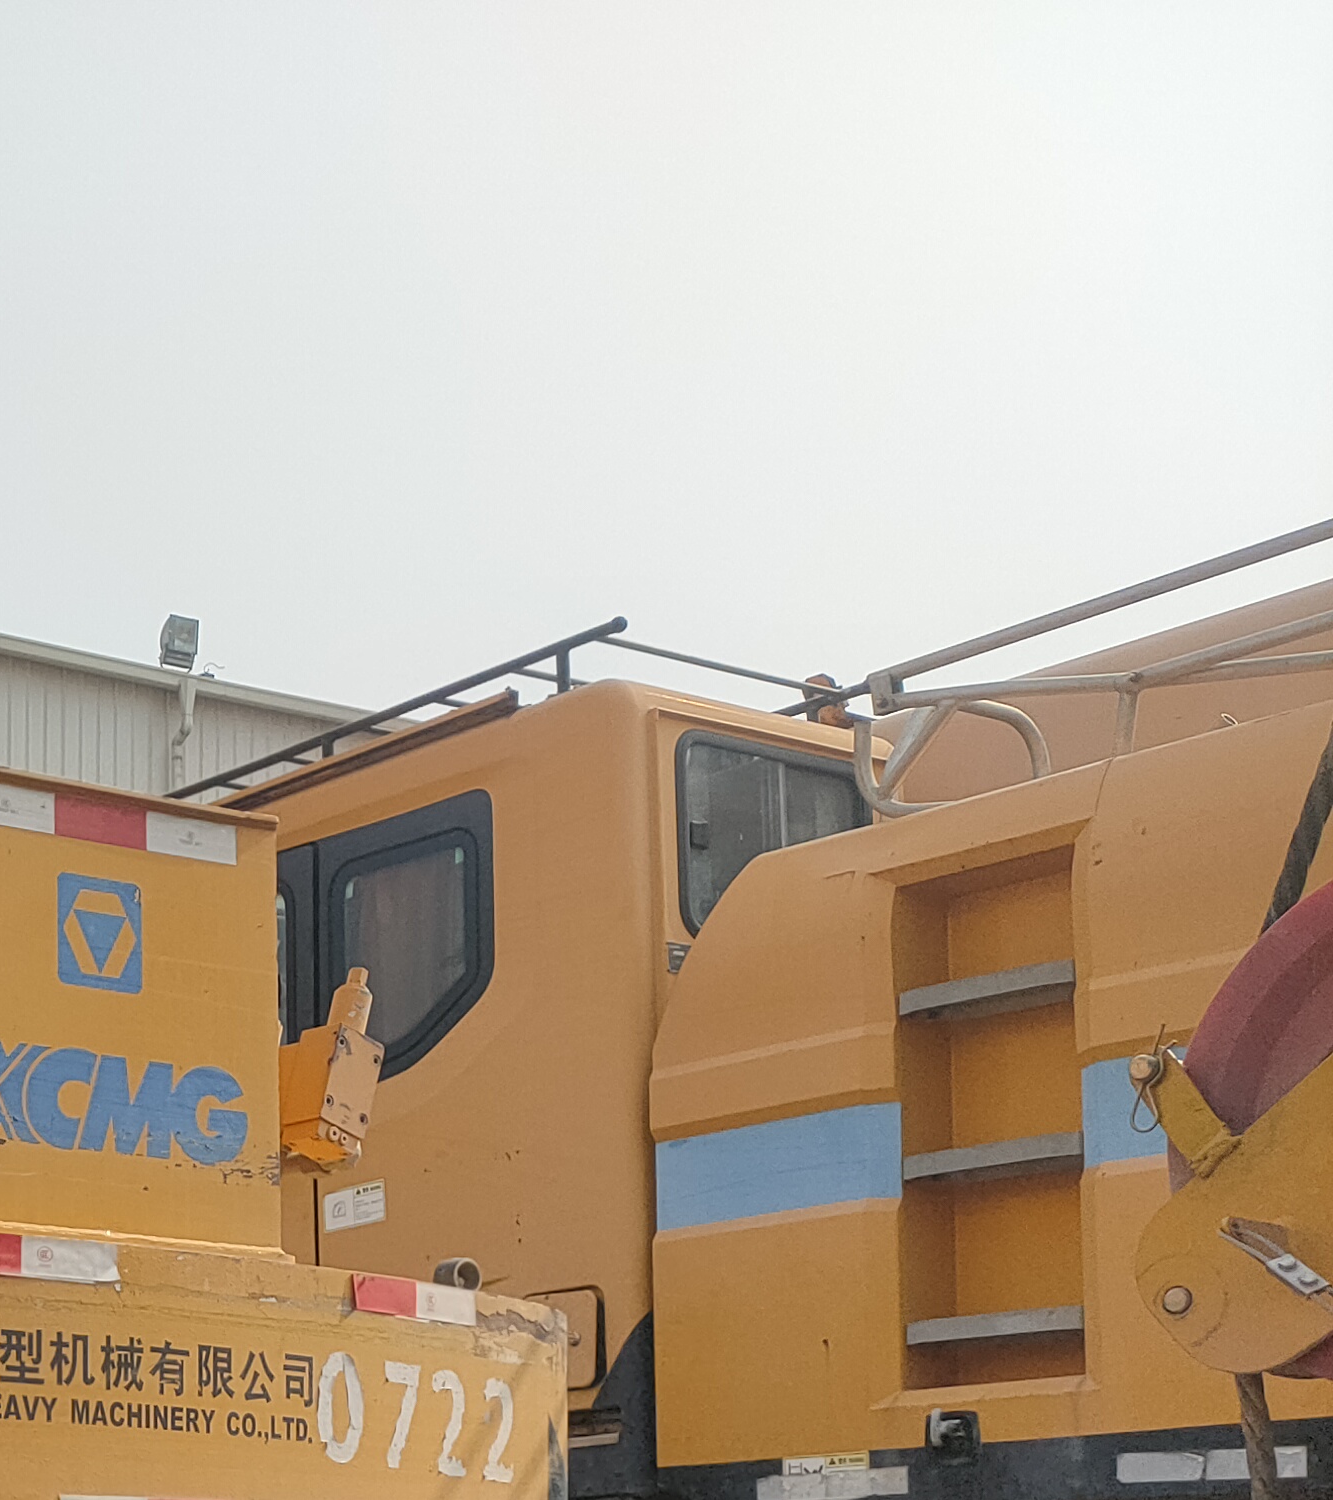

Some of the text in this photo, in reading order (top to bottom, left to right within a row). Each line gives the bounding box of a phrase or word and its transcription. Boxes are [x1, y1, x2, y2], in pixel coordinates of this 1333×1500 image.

[70, 1401, 216, 1436] MACHINERY
[226, 1410, 314, 1445] CO.,LTD.
[318, 1350, 515, 1484] 0722
